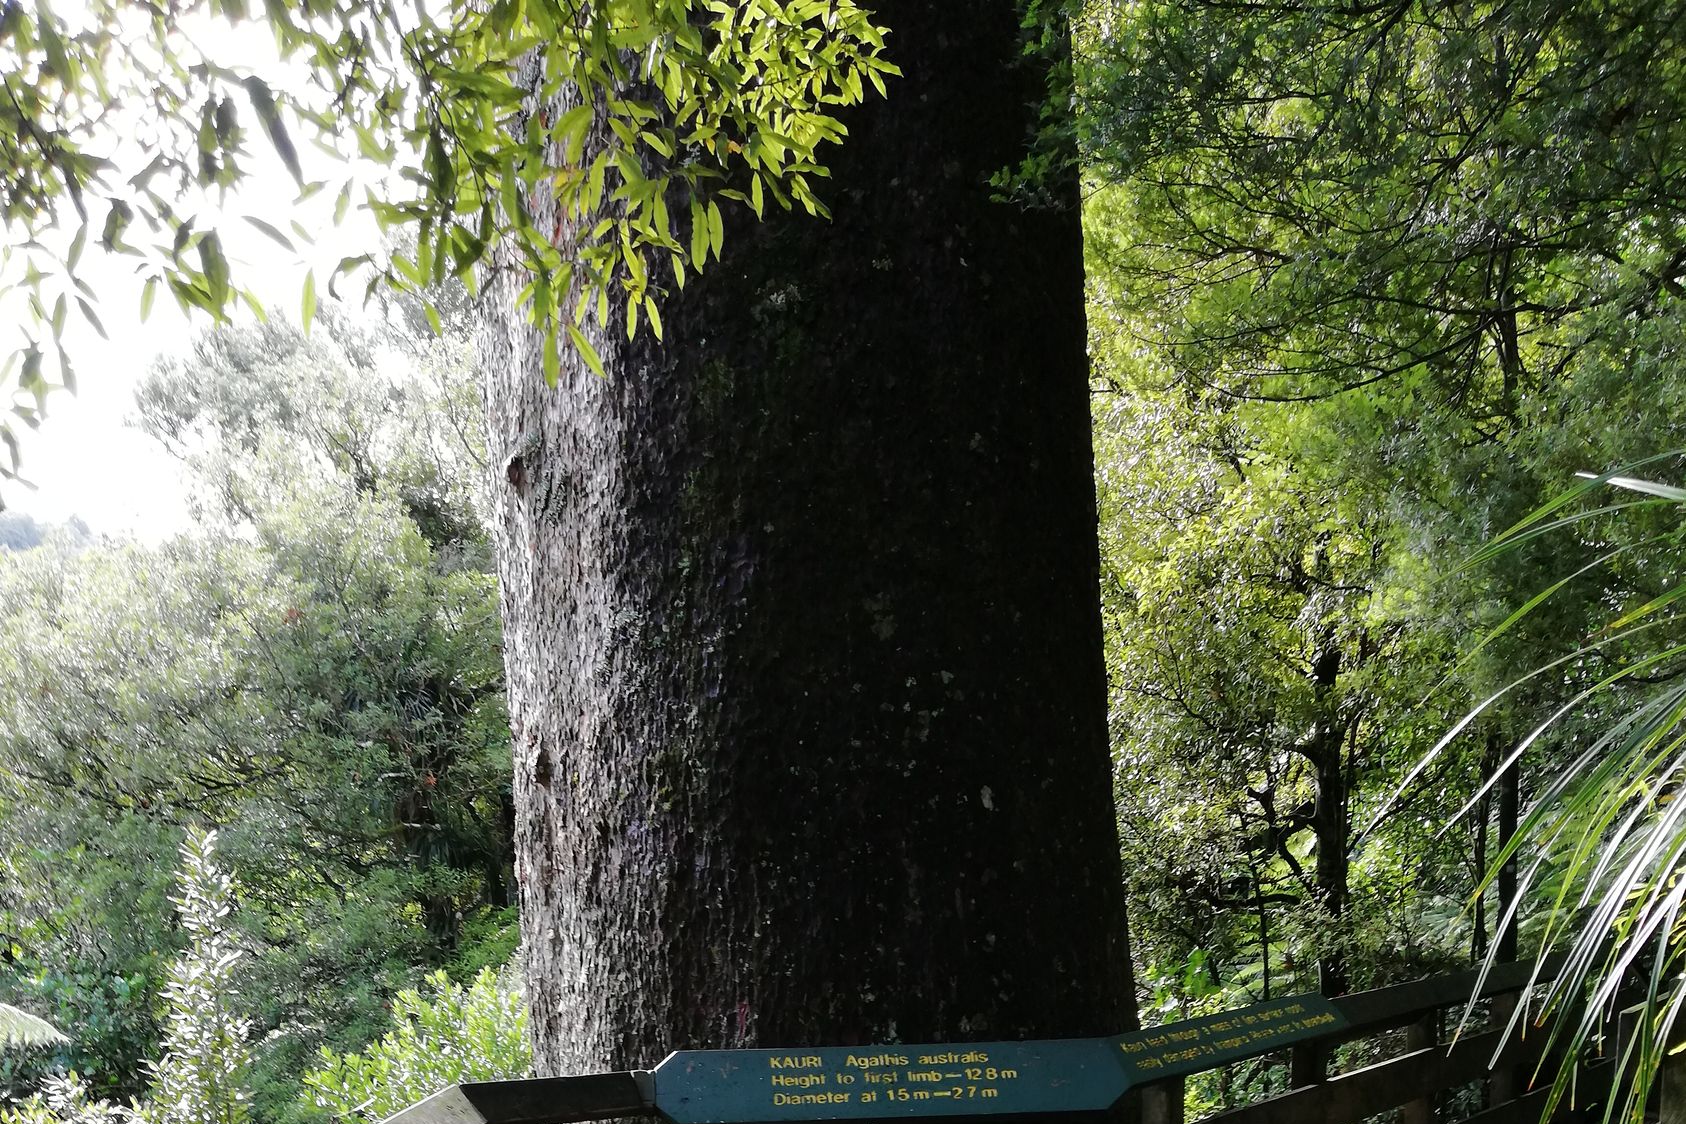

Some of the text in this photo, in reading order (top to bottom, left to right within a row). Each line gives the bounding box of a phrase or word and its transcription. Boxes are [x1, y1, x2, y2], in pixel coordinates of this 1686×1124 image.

[769, 1050, 989, 1069] KAURI Agathis australis
[771, 1074, 826, 1088] Height
[836, 1072, 855, 1085] to
[864, 1070, 898, 1084] first
[773, 1092, 851, 1106] Diameter
[861, 1090, 877, 1103] at
